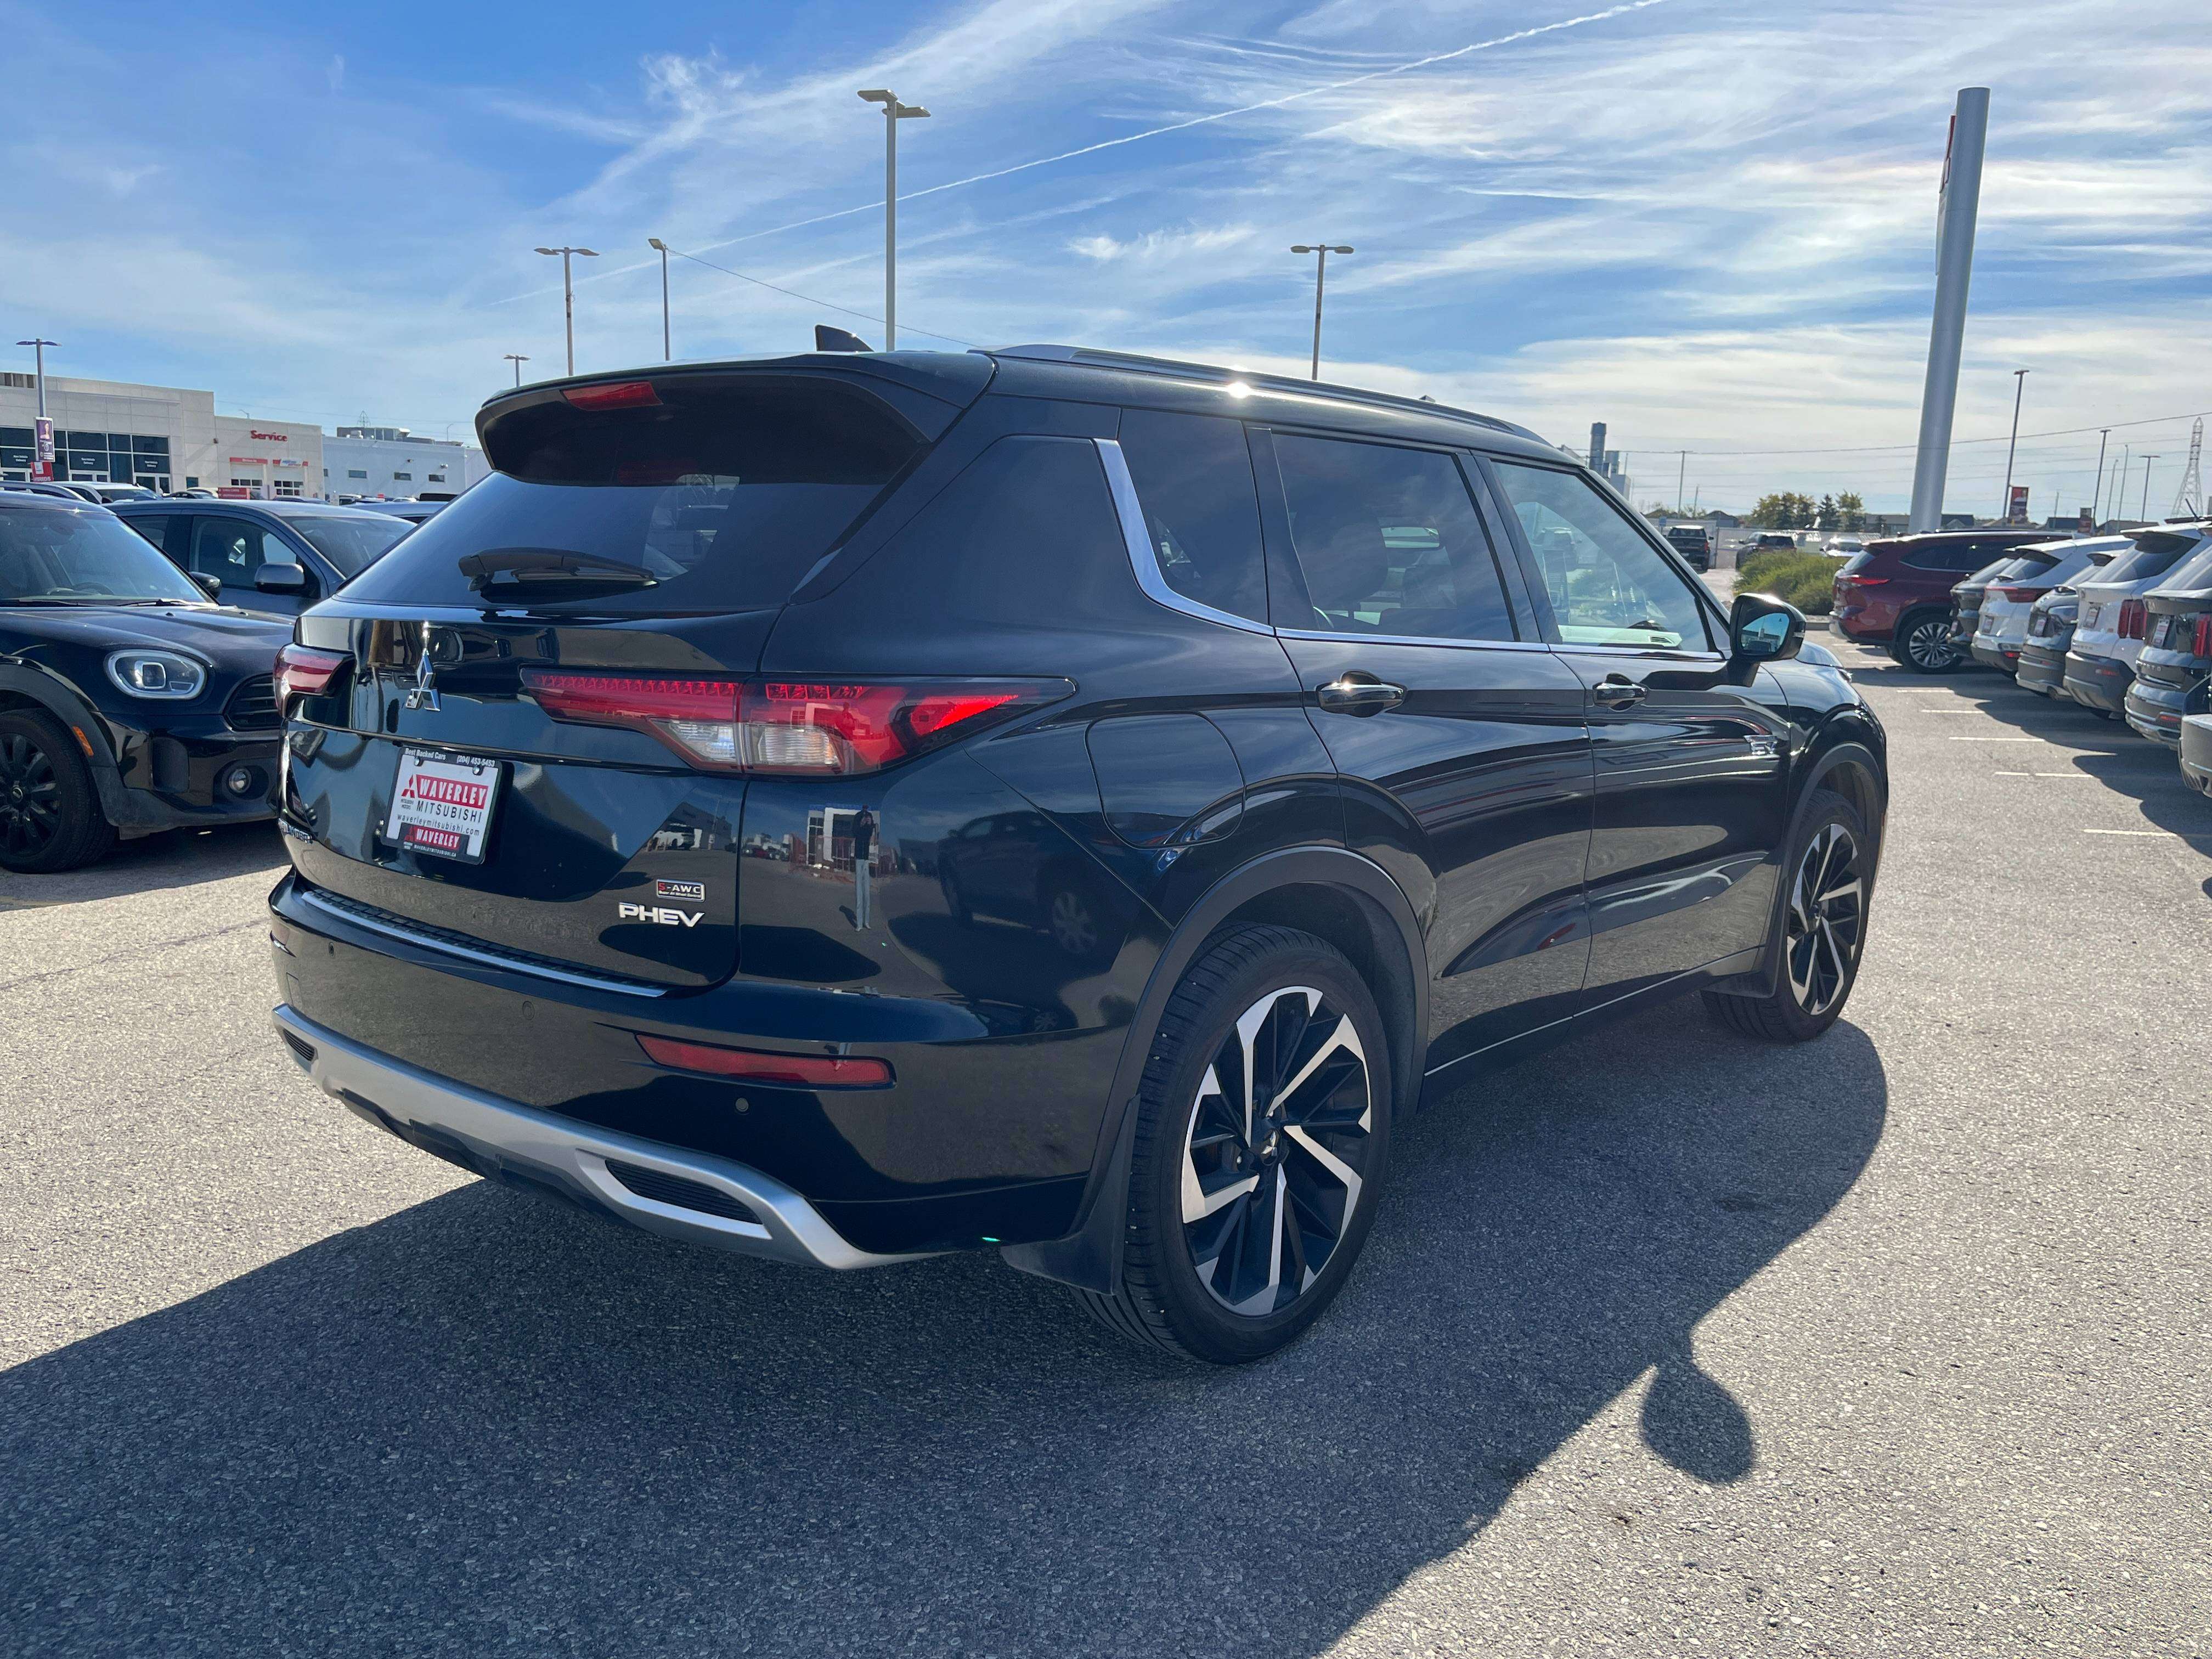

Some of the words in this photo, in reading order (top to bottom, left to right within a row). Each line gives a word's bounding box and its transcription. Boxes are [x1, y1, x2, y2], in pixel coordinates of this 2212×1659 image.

[251, 430, 287, 442] Service
[405, 747, 416, 755] Best
[435, 752, 447, 760] Cars
[456, 754, 470, 765] (204)
[471, 757, 495, 767] 453-5453
[419, 778, 487, 806] WAVERLEY
[416, 800, 482, 823] MITSUBISHI
[397, 814, 479, 836] waverleymitsubishi.com
[416, 828, 460, 848] WAVERLEY
[658, 882, 701, 894] S-AWC
[619, 902, 705, 928] PHEV
